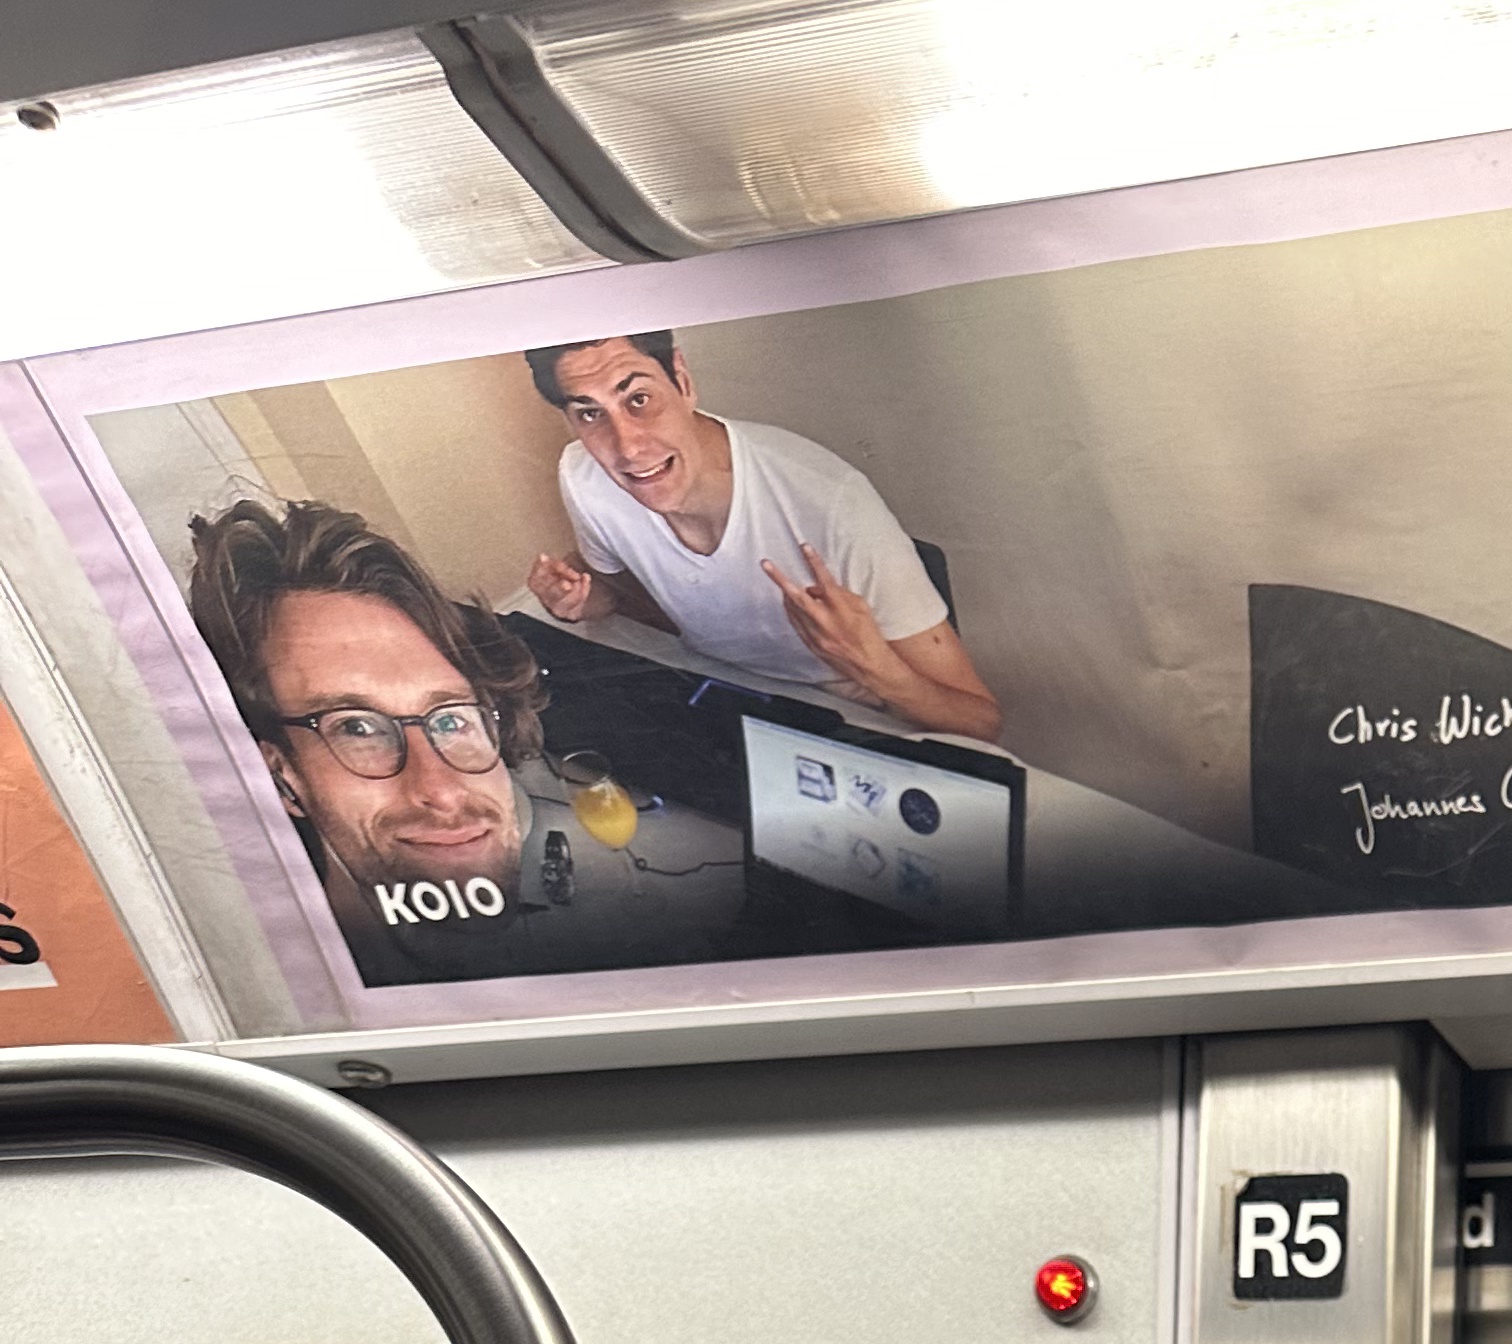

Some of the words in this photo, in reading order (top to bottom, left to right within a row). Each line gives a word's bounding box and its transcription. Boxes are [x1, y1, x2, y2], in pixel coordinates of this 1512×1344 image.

[1328, 705, 1418, 744] Chris
[1340, 782, 1487, 854] Johannes
[374, 876, 505, 925] KOIO
[1238, 1200, 1342, 1279] R5
